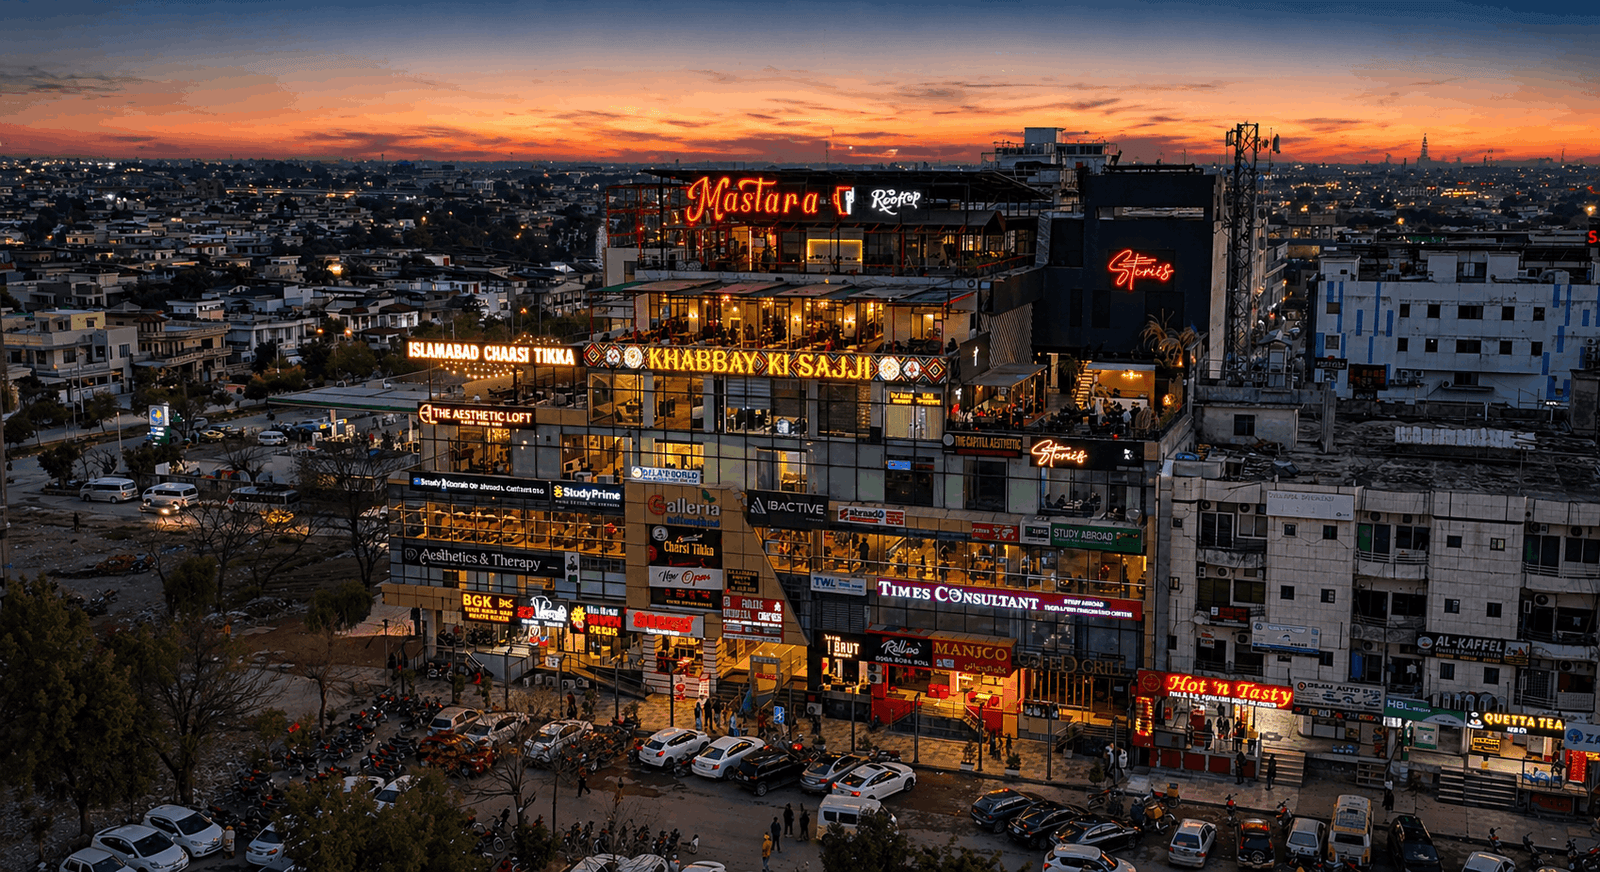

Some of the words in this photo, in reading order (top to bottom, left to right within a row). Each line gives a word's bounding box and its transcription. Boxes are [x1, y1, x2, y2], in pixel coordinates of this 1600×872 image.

[687, 176, 819, 221] Mastara
[871, 188, 921, 215] Rooftop
[1109, 249, 1174, 290] Stories
[408, 341, 479, 360] ISLAMABAD
[533, 347, 576, 366] TIKKA
[649, 347, 758, 374] KHABBAY
[767, 351, 790, 377] KI
[798, 353, 871, 380] SAJJI
[432, 408, 451, 419] THE
[453, 409, 506, 422] AESTHETIC
[506, 412, 532, 424] LOFT
[1031, 439, 1088, 467] Stories
[563, 487, 621, 500] StudyPrime
[648, 494, 720, 516] Galleria
[767, 500, 824, 515] IBACTIVE
[1053, 528, 1079, 539] STUDY
[1081, 530, 1113, 541] ABROAD
[664, 540, 690, 554] Charsi
[420, 549, 478, 565] Aesthetics
[479, 552, 489, 565] &
[491, 553, 541, 571] Therapy
[813, 576, 836, 588] TWL
[462, 593, 492, 608] BGK
[878, 580, 931, 600] TIMES
[934, 585, 1039, 611] CONSULTANT
[834, 641, 859, 655] BRUT
[1167, 676, 1207, 694] Hot
[1237, 683, 1292, 707] Tasty
[1387, 699, 1411, 711] HBL
[1484, 712, 1536, 728] QUETTA
[1538, 717, 1563, 731] TEA
